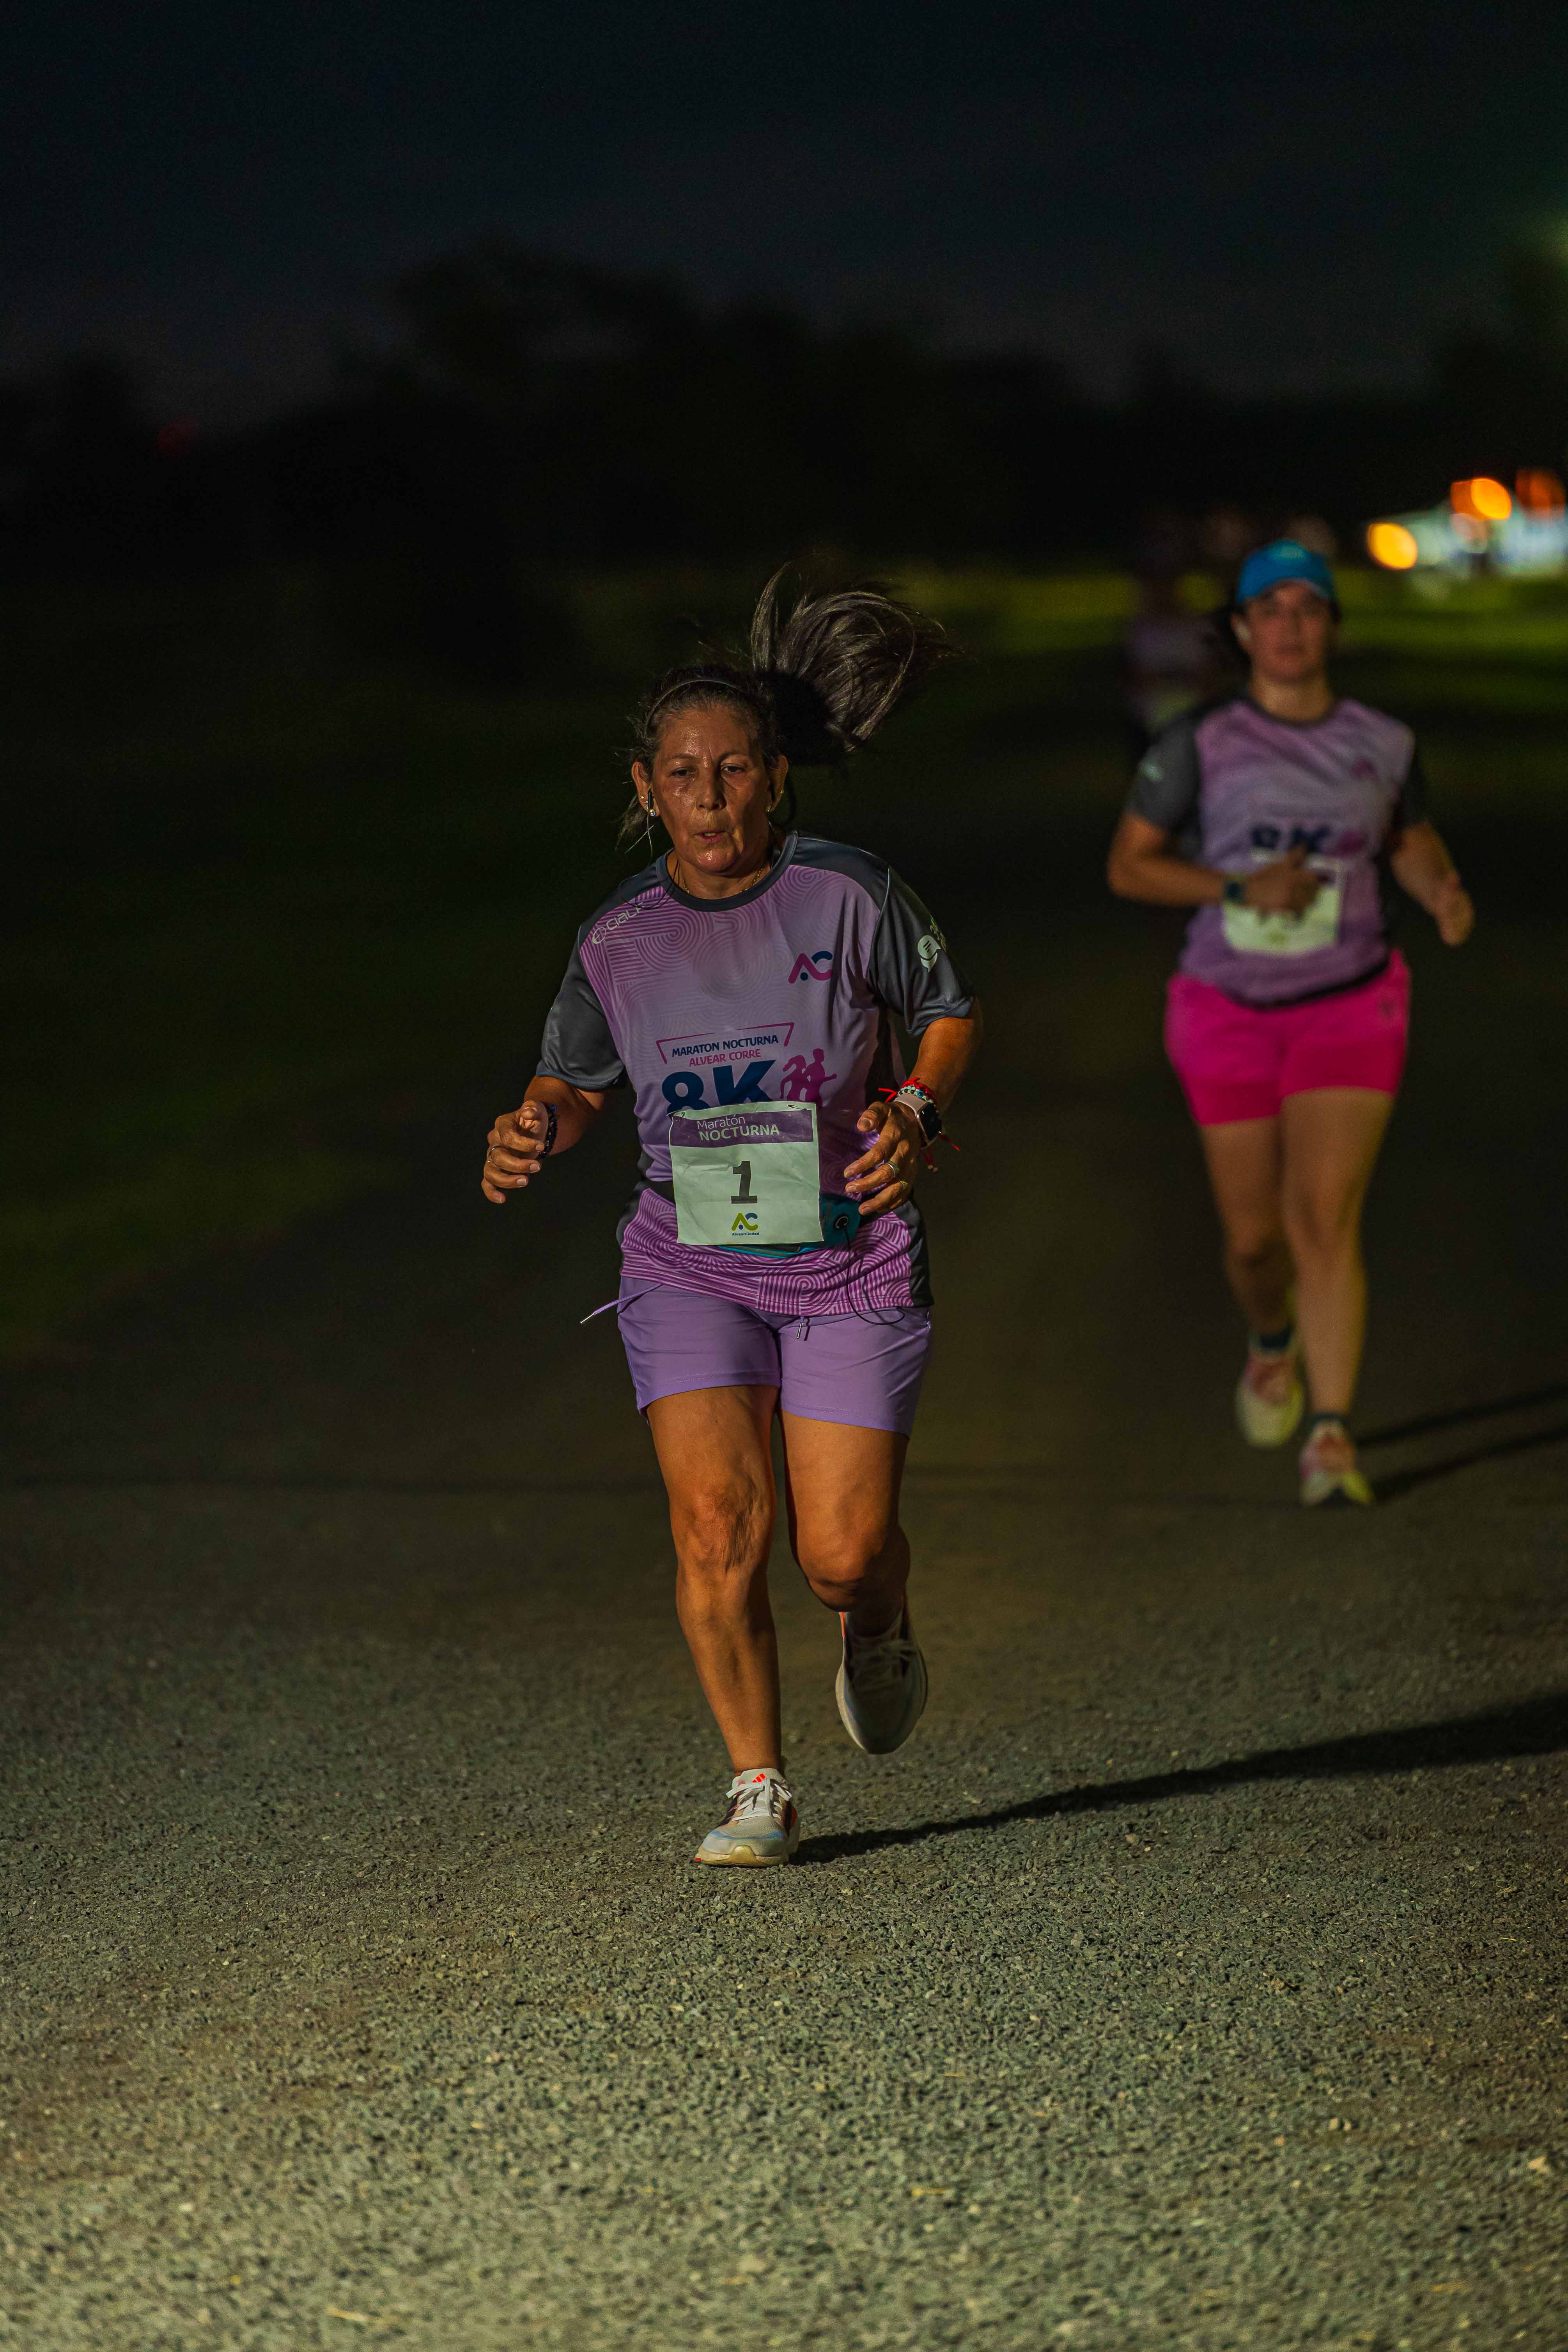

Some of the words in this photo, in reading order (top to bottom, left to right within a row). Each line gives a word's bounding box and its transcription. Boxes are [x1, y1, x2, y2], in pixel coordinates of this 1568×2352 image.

[672, 1042, 719, 1057] MARATON
[723, 1035, 779, 1050] NOCTURNA
[689, 1056, 726, 1067] ALVEAR
[729, 1049, 761, 1061] CORRE
[662, 1060, 776, 1112] 8K
[697, 1114, 746, 1130] Maratón
[699, 1124, 780, 1141] NOCTURNA
[731, 1161, 757, 1204] 1
